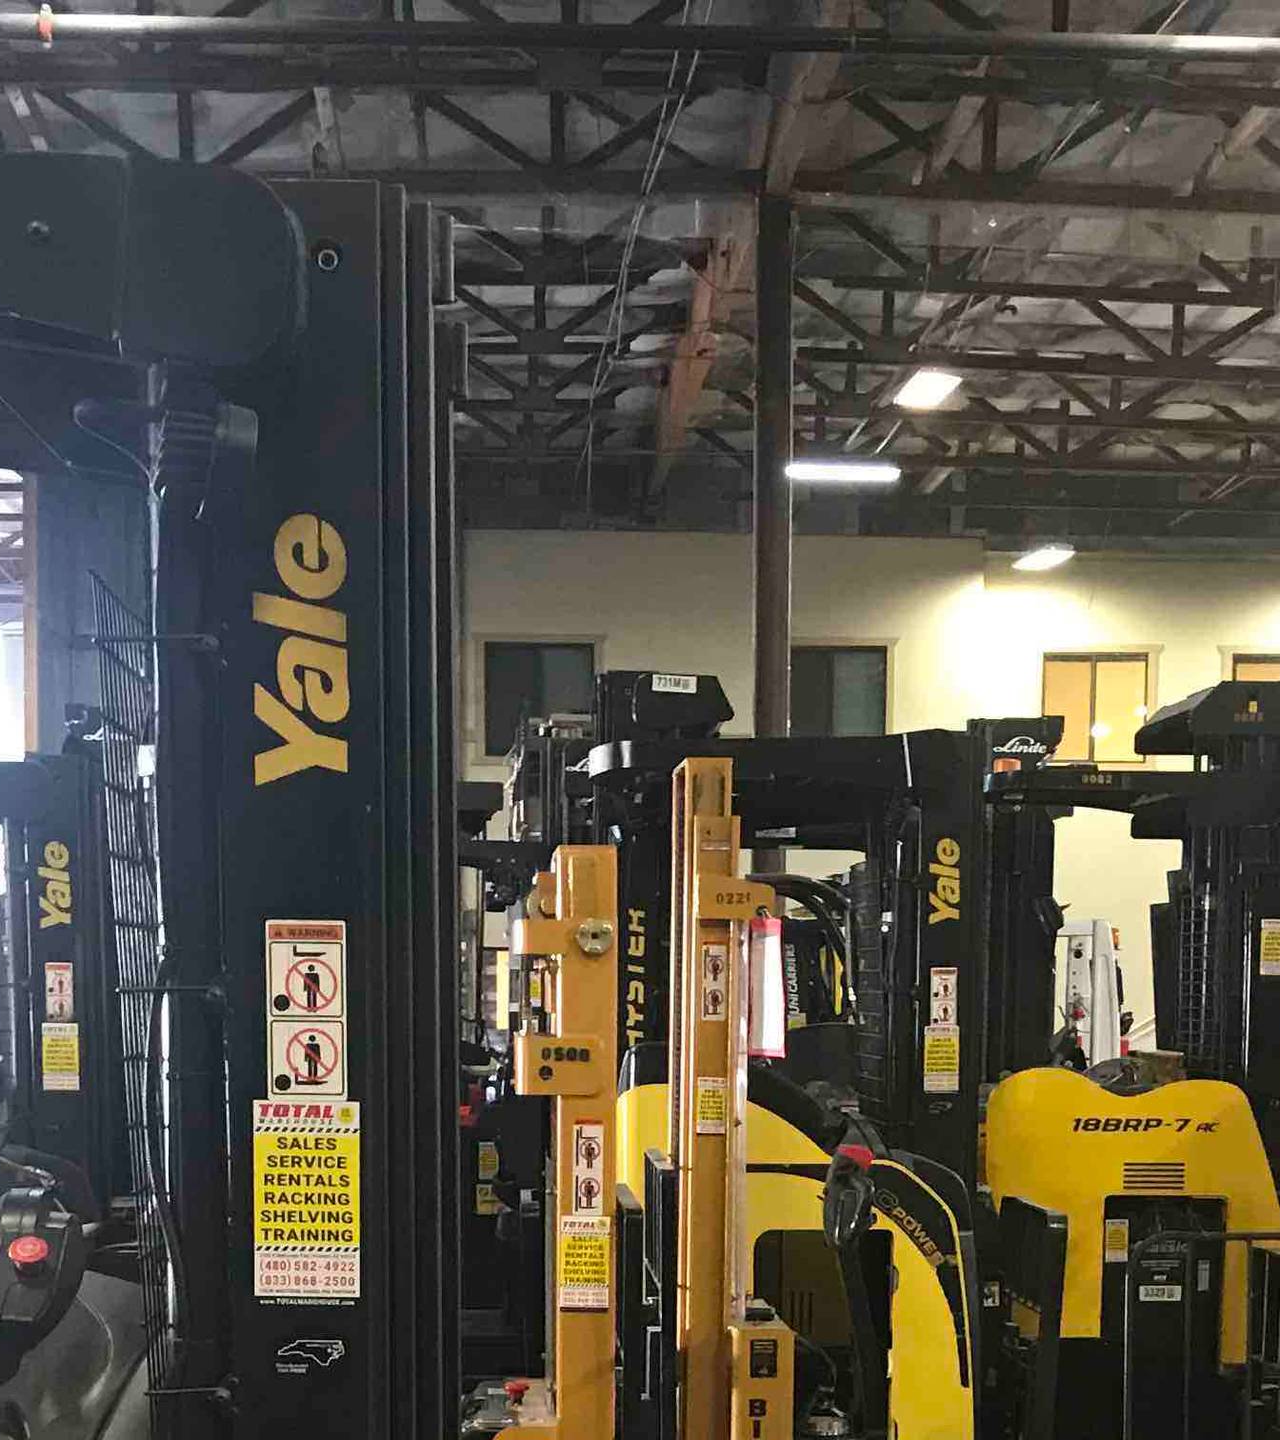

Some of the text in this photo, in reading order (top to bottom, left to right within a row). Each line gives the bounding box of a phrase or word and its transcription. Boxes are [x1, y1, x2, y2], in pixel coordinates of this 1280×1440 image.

[252, 512, 348, 786] Yale
[993, 736, 1047, 753] Linde
[38, 841, 71, 928] Yale
[929, 838, 960, 925] Yale
[259, 1104, 334, 1118] TOTAL
[1073, 1118, 1191, 1132] 18BRP-7
[277, 1137, 337, 1150] SALES
[267, 1155, 347, 1168] SERVICE
[264, 1174, 350, 1187] RENTALS
[264, 1192, 350, 1205] RACKING
[260, 1210, 353, 1224] SHELVING
[261, 1228, 353, 1242] TRAINING
